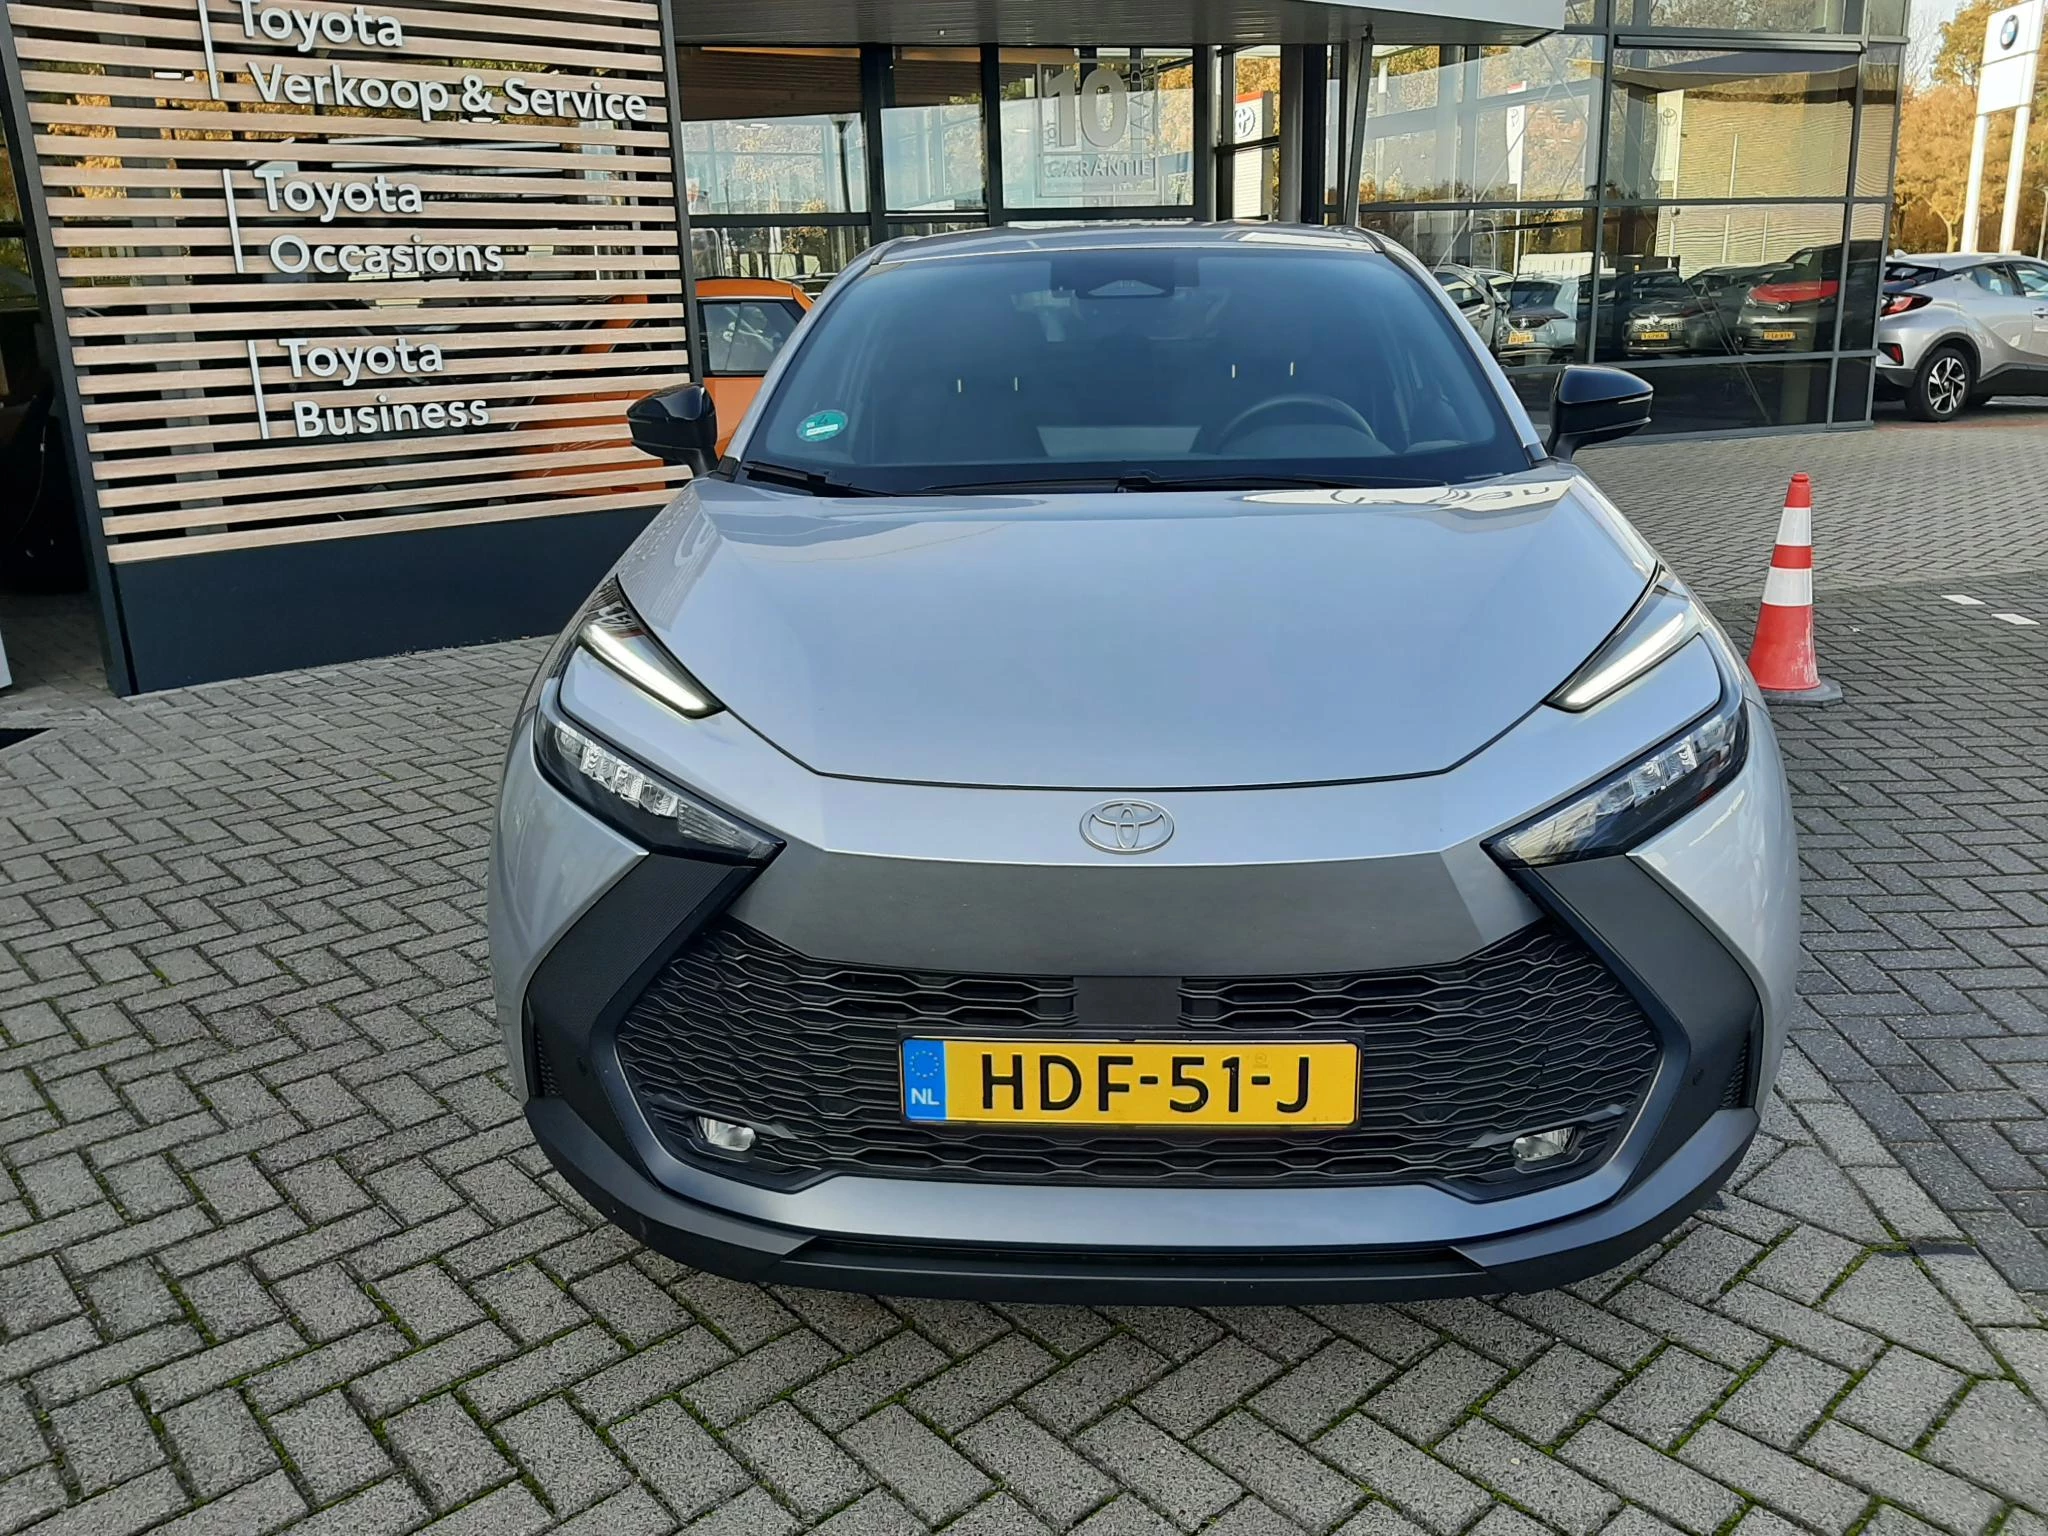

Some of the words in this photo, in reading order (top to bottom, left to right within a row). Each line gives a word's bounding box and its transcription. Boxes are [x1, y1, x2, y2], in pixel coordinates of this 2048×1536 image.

[235, 0, 403, 52] Toyota
[246, 61, 449, 122] Verkoop
[459, 74, 495, 114] &
[503, 77, 648, 122] Service
[1046, 69, 1128, 148] 10
[1044, 158, 1151, 178] GARANTIE
[253, 168, 424, 222] Toyota
[269, 233, 505, 274] Occasions
[278, 336, 444, 386] Toyota
[293, 394, 490, 438] Business
[911, 1088, 940, 1106] NL
[981, 1053, 1310, 1113] HDF-51-J
